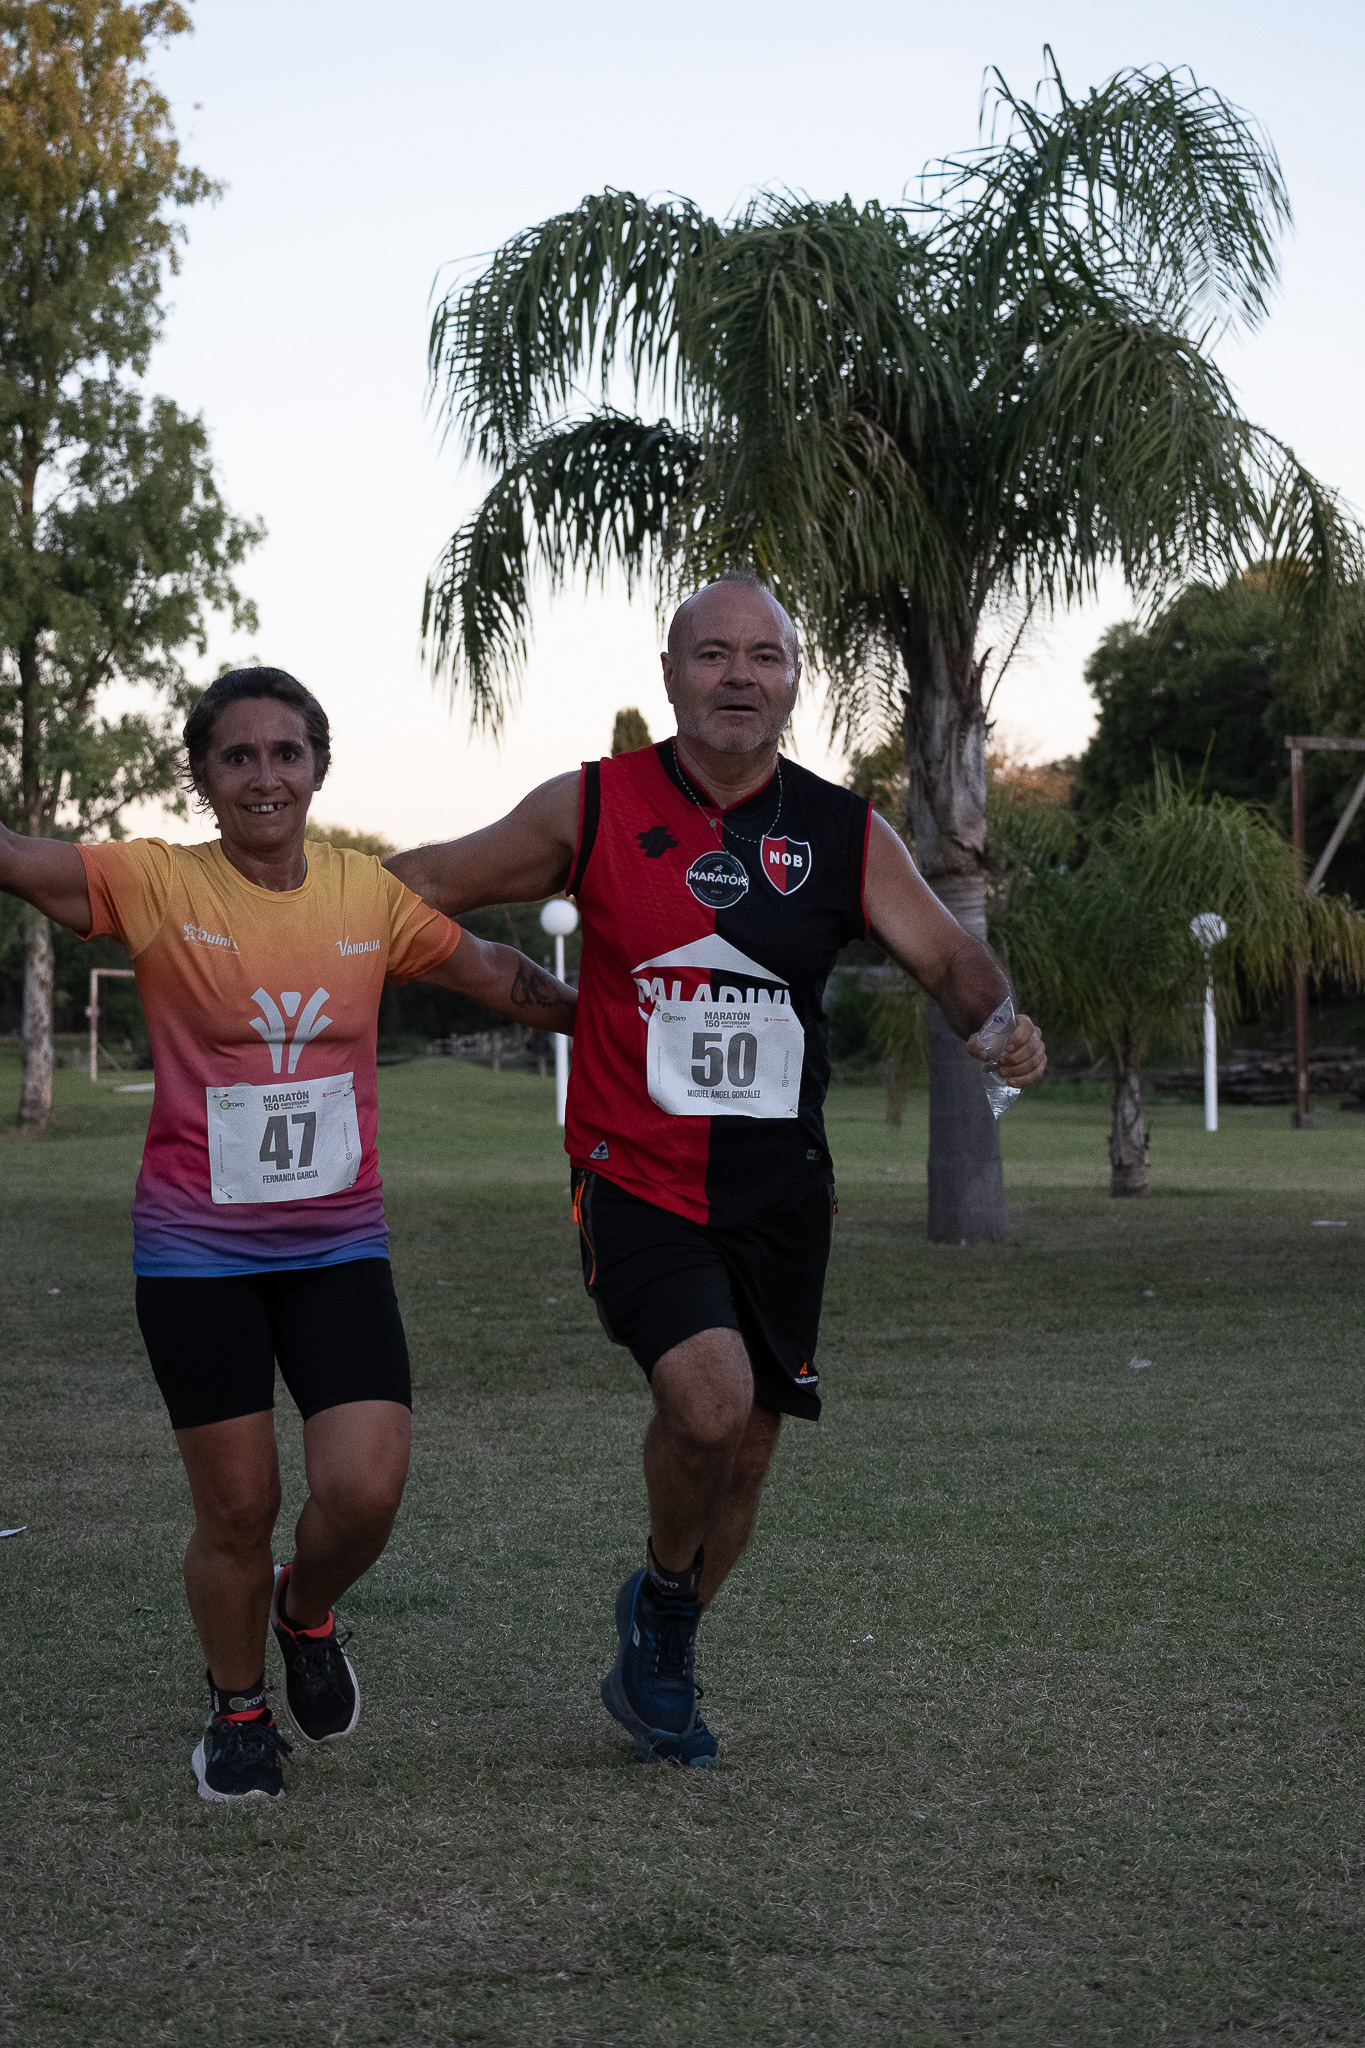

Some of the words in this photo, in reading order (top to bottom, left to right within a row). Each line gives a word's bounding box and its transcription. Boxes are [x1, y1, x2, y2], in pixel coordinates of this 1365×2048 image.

[769, 850, 803, 868] NOB
[335, 935, 380, 957] VANDALIA
[704, 1010, 750, 1021] MARATÓN
[704, 1020, 720, 1028] 150
[691, 1032, 758, 1087] 50
[263, 1090, 309, 1103] MARATÓN
[687, 1089, 710, 1099] MIGUEL
[711, 1088, 731, 1099] ÁNGEL
[731, 1088, 761, 1099] GONZÁLEZ
[263, 1102, 280, 1111] 150
[259, 1111, 317, 1170] 47
[262, 1172, 296, 1183] FERNANDA
[296, 1169, 319, 1181] GARCIA
